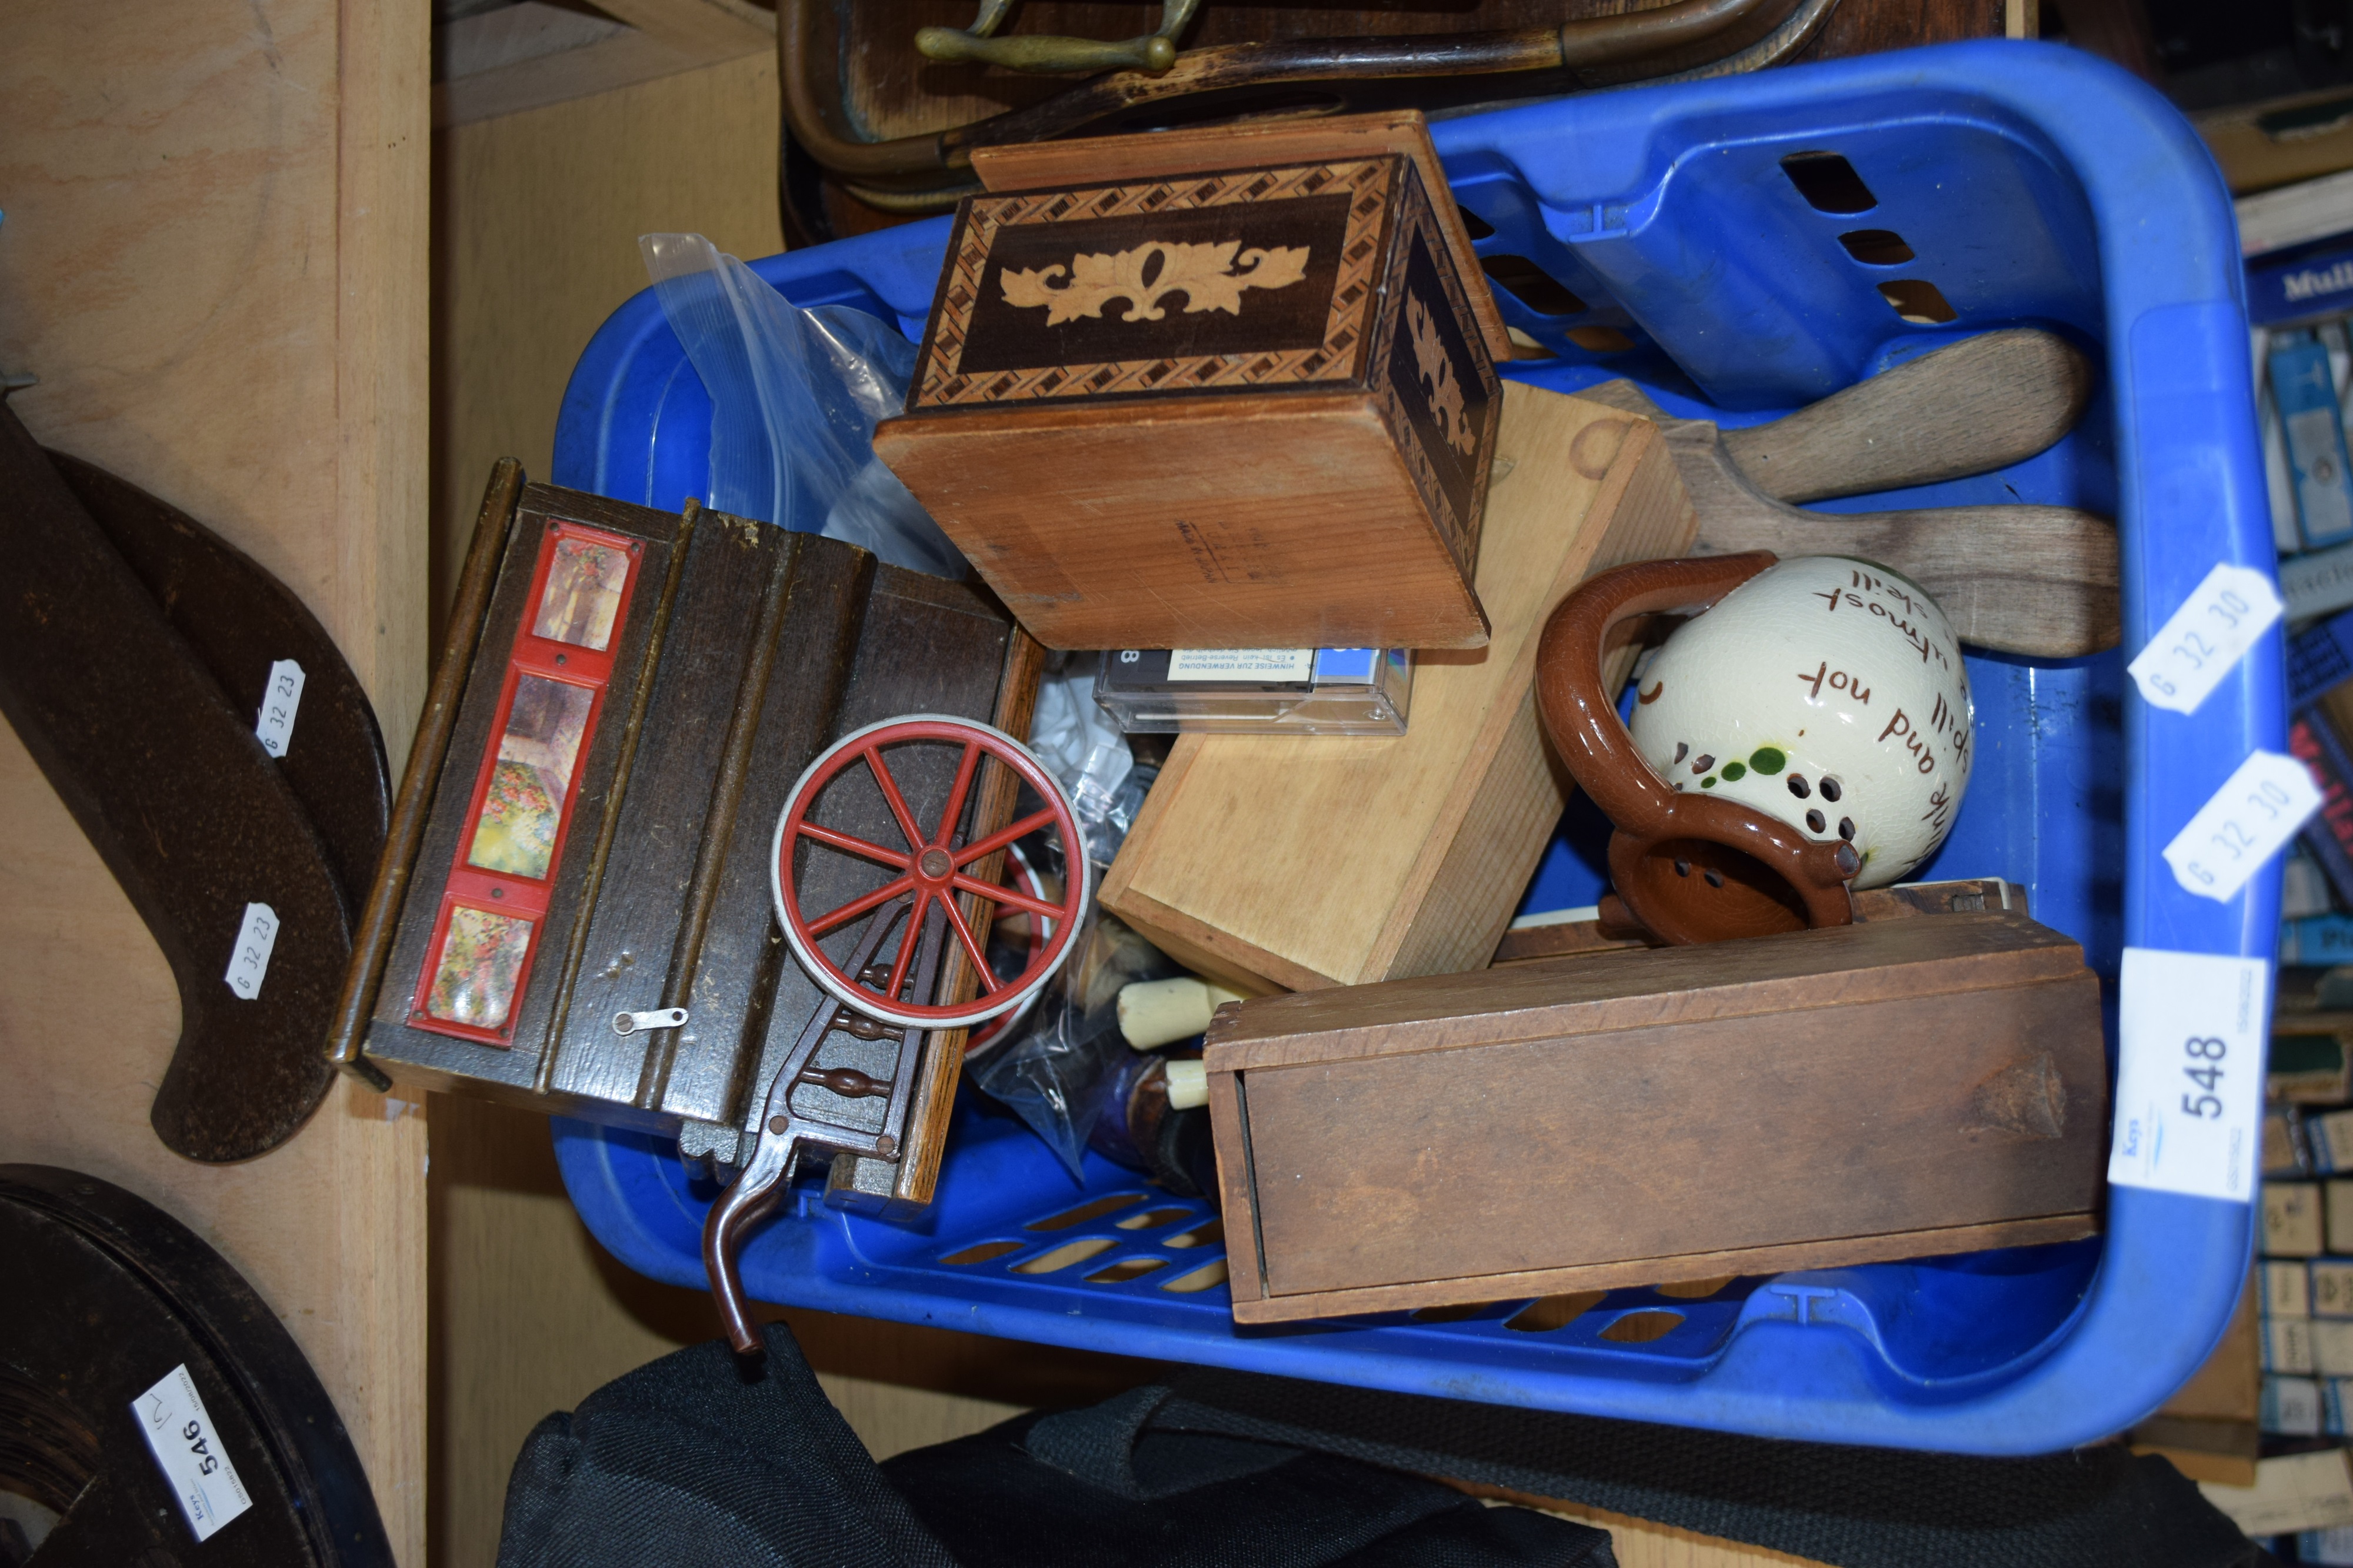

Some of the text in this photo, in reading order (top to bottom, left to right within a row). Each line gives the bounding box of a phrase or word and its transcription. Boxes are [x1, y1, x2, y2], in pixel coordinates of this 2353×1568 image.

[1852, 571, 1928, 619] skill
[1812, 588, 1948, 670] utmost
[2174, 632, 2215, 669] 32
[2209, 590, 2250, 628] 30
[277, 675, 295, 697] 23
[1798, 661, 1871, 705] not
[270, 706, 287, 729] 32
[1878, 708, 1935, 775] and
[1931, 692, 1971, 775] spill
[2212, 820, 2255, 860] 32
[2248, 780, 2289, 819] 30
[243, 945, 262, 970] 32
[253, 916, 271, 940] 23
[2180, 1036, 2226, 1120] 548
[2122, 1118, 2141, 1157] Keys
[182, 1419, 219, 1476] 546
[189, 1494, 204, 1522] Keys
